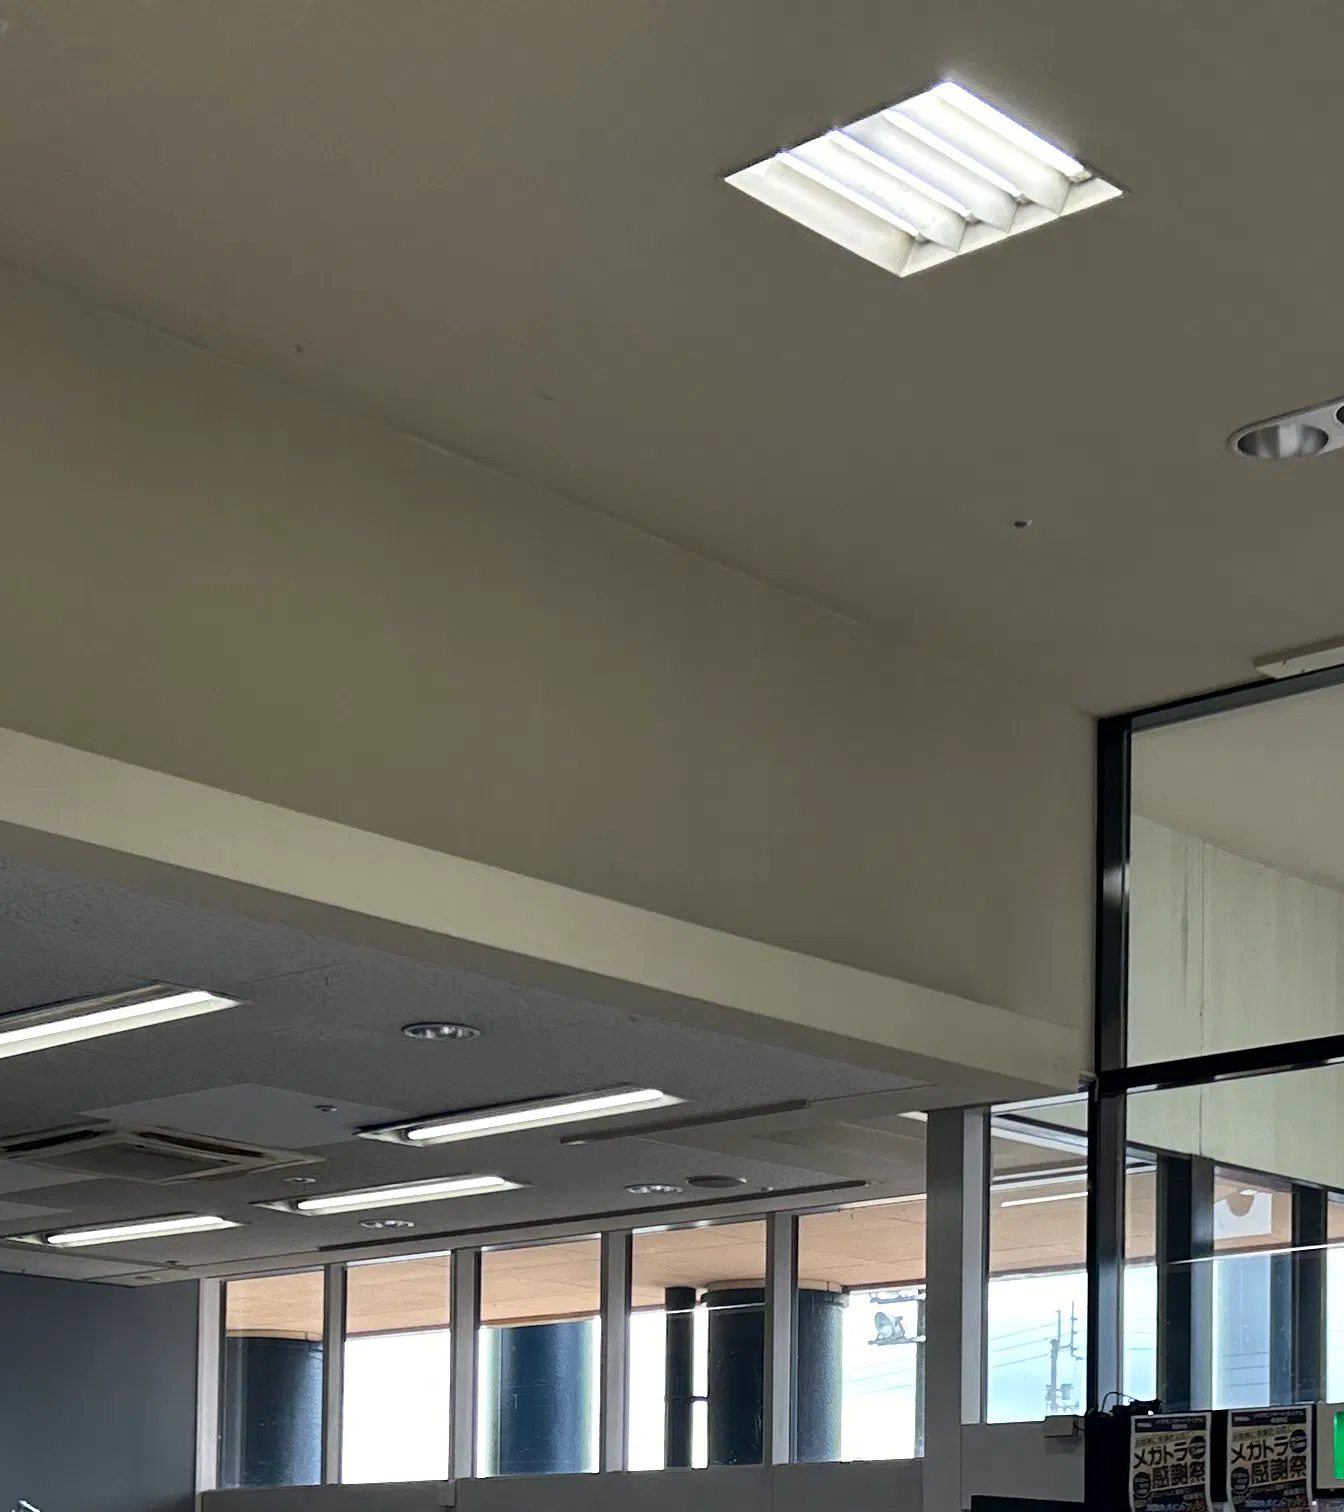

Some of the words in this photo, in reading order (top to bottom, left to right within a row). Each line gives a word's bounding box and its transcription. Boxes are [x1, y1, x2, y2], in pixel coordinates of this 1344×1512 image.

[1133, 1441, 1189, 1469] メガトラ
[1231, 1436, 1289, 1464] メガトラ
[1152, 1461, 1206, 1489] 感謝祭
[1251, 1455, 1307, 1484] 感謝祭
